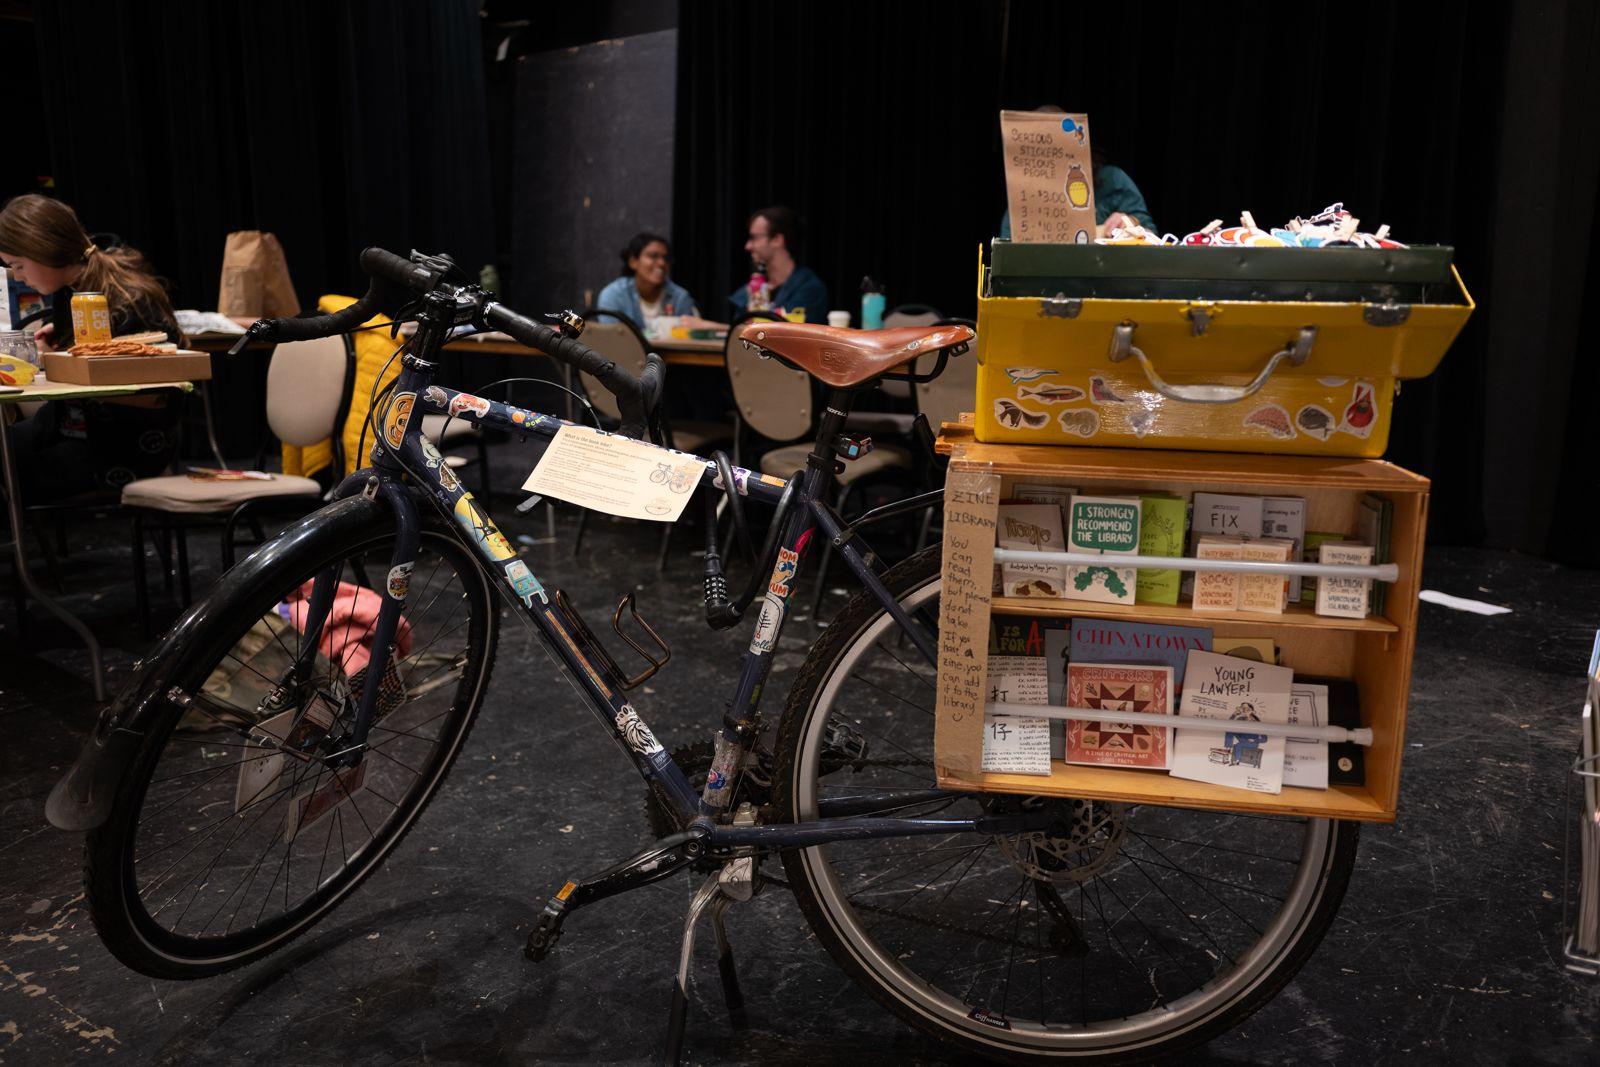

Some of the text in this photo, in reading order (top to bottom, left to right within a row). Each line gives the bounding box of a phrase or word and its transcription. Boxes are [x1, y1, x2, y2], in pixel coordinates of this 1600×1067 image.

[1020, 146, 1064, 158] STICKERS
[1012, 156, 1056, 169] SERIOUS
[1024, 169, 1056, 179] PEOPLE
[952, 490, 994, 505] ZINE
[948, 510, 996, 528] LIBRARY
[1078, 506, 1134, 520] I STRONGLY
[1077, 519, 1132, 532] RECOMMEND
[1211, 513, 1239, 529] FIX
[1077, 531, 1133, 544] THE LIBRARY
[780, 550, 797, 562] OM
[952, 552, 973, 564] can
[948, 562, 971, 576] read
[1201, 574, 1234, 586] ROCKS
[948, 586, 962, 596] but
[1003, 626, 1020, 637] IS
[1000, 638, 1026, 652] FOR
[1214, 666, 1255, 682] YOUNG
[964, 676, 980, 687] add
[964, 688, 978, 700] the
[1200, 682, 1251, 697] LAWYER!
[944, 696, 975, 716] library
